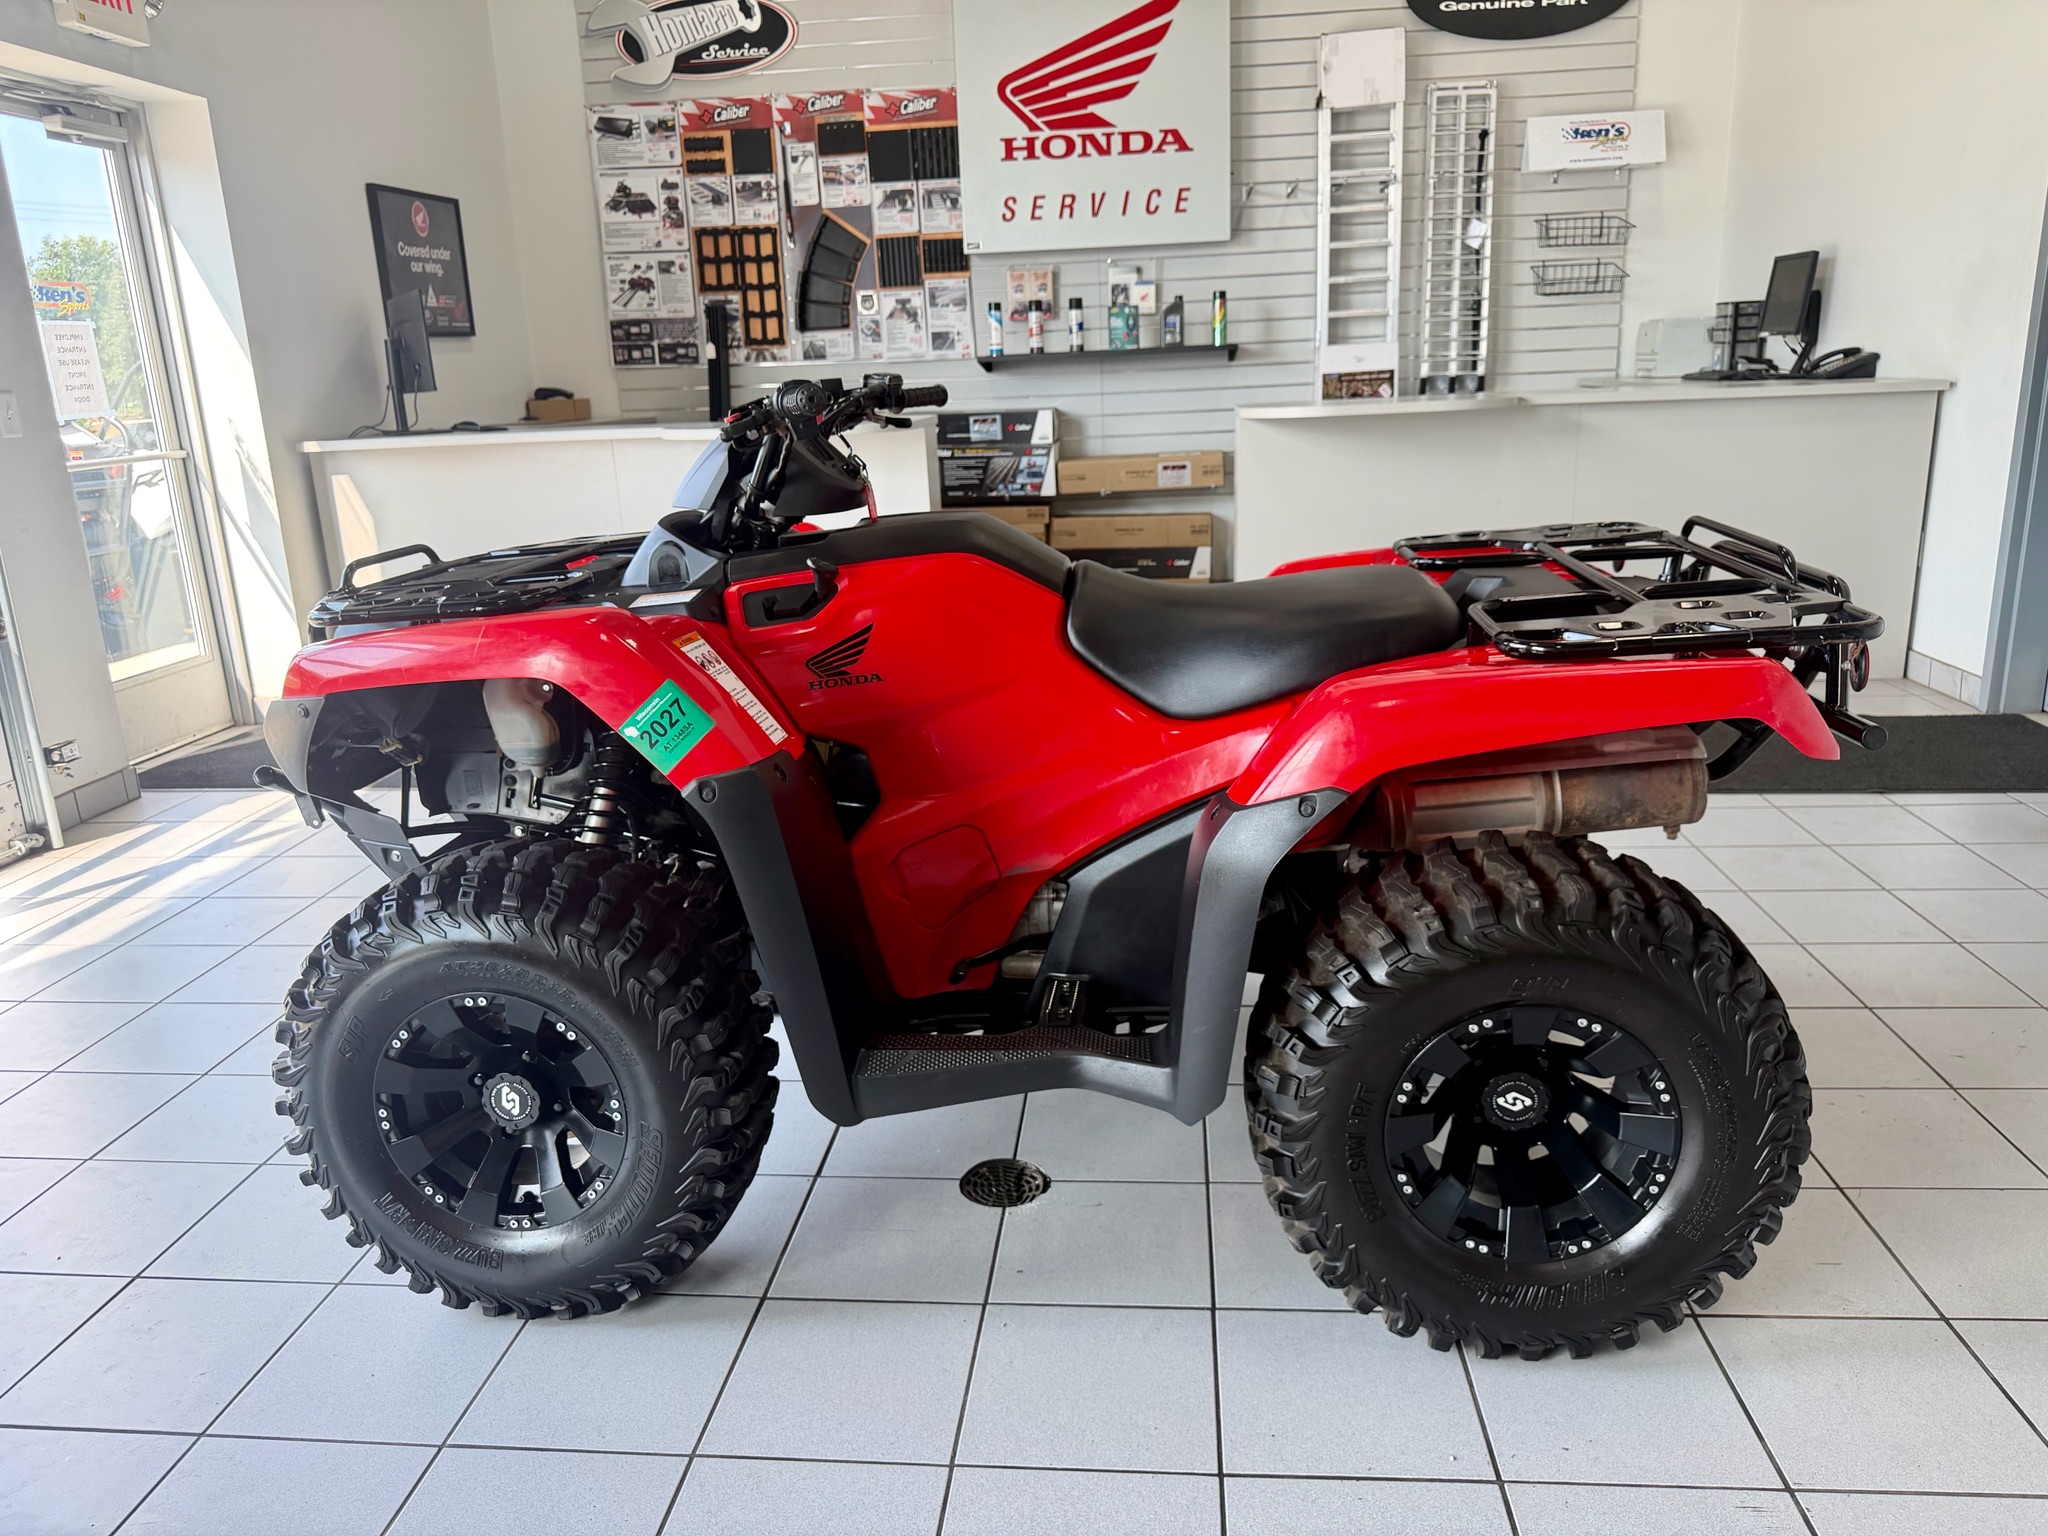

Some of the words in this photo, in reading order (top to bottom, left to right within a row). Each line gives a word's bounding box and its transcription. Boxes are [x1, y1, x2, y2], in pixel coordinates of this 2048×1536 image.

[1439, 0, 1535, 11] Genuine
[639, 3, 739, 57] HondaPro
[701, 43, 771, 60] Service
[714, 104, 751, 123] Caliber
[807, 93, 845, 112] Caliber
[900, 95, 938, 115] Caliber
[1000, 128, 1194, 162] HONDA
[1001, 187, 1192, 223] SERVICE
[397, 241, 430, 258] Covered
[431, 246, 451, 260] under
[410, 260, 424, 273] our
[424, 260, 444, 277] wing.
[57, 298, 90, 317] Sports
[808, 672, 883, 691] HONDA
[635, 697, 661, 721] Wisconsin
[640, 697, 687, 750] 2027
[663, 741, 673, 752] AT
[672, 721, 693, 743] 1348SA
[1345, 1133, 1368, 1172] SAW
[608, 1120, 664, 1239] SEDONA
[411, 1221, 455, 1255] SAW
[453, 1239, 504, 1272] BUZZ
